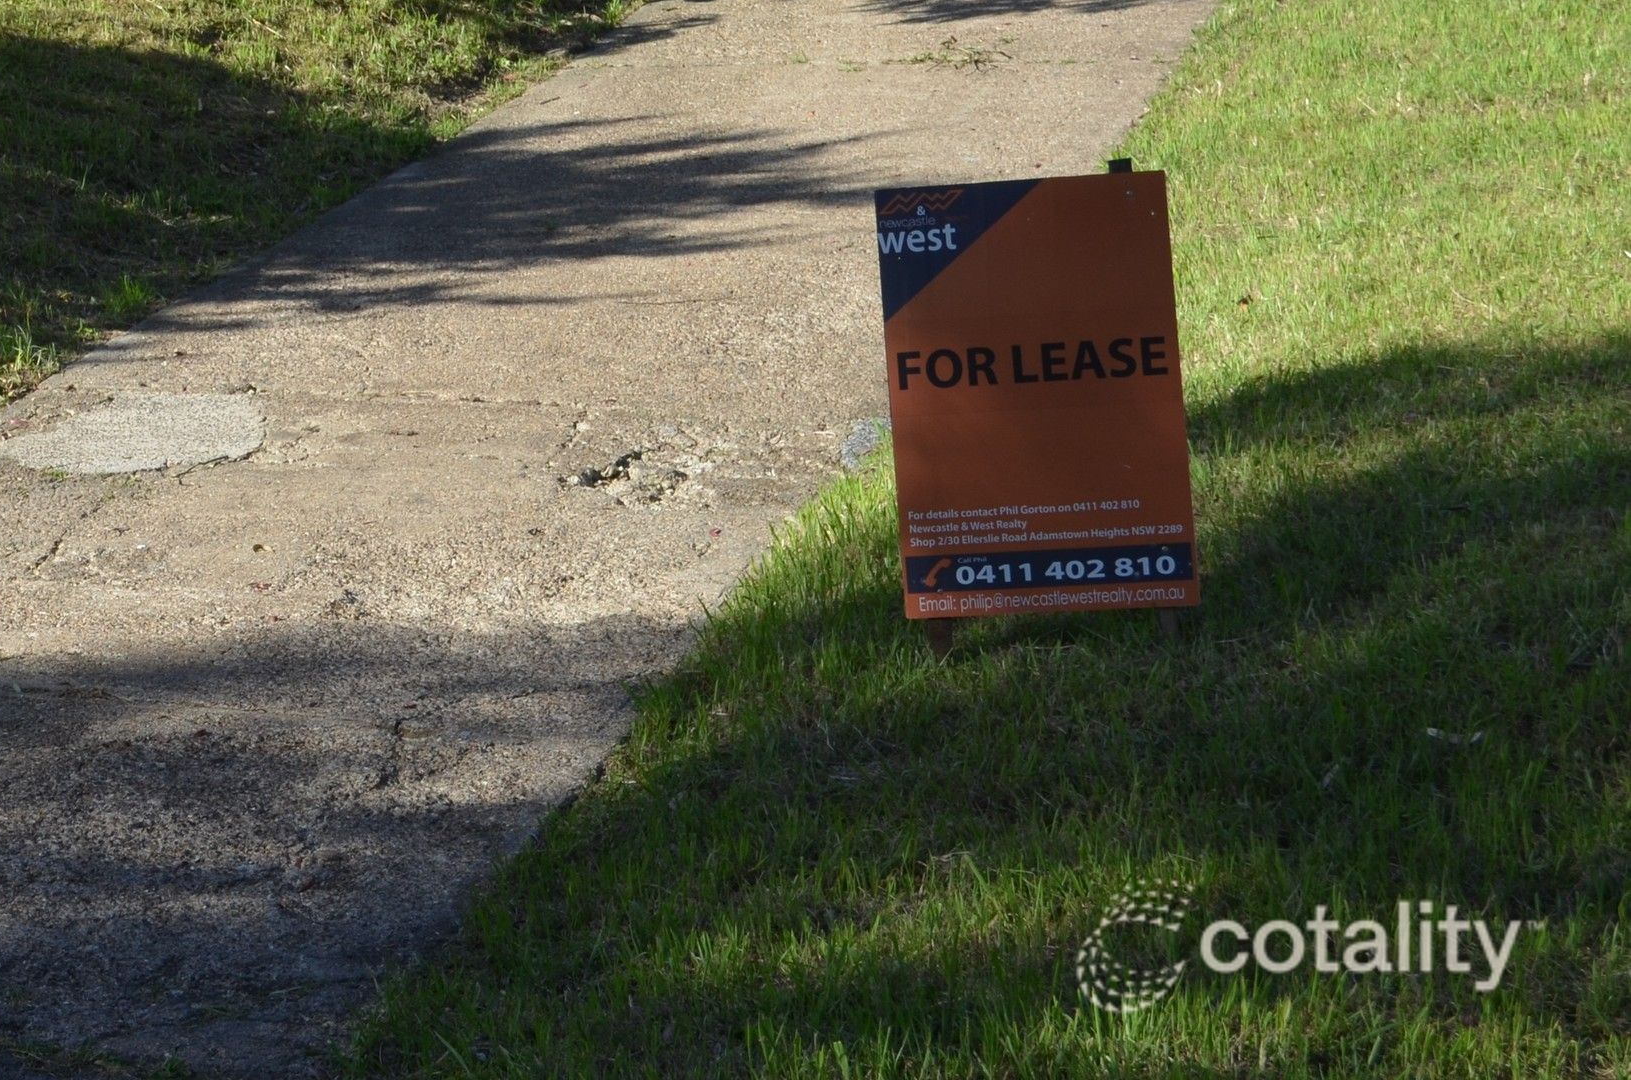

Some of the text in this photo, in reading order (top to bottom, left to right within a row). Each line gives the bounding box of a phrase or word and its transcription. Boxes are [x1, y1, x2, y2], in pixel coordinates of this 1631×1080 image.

[880, 215, 937, 229] newcastle
[917, 205, 925, 216] &
[877, 223, 957, 254] west
[897, 336, 1169, 391] FOR LEASE
[908, 499, 1140, 520] For details contact Phil Gorton on 0411 402 810
[909, 519, 1027, 533] Newcastle & West Realty
[910, 524, 1183, 548] Shop 2/30 Ellerslie Road Adamstown Heights NSW 2289
[955, 555, 1176, 585] 0411 402 810
[918, 587, 1185, 613] Email: philip@newcastlewestrealty.com.au
